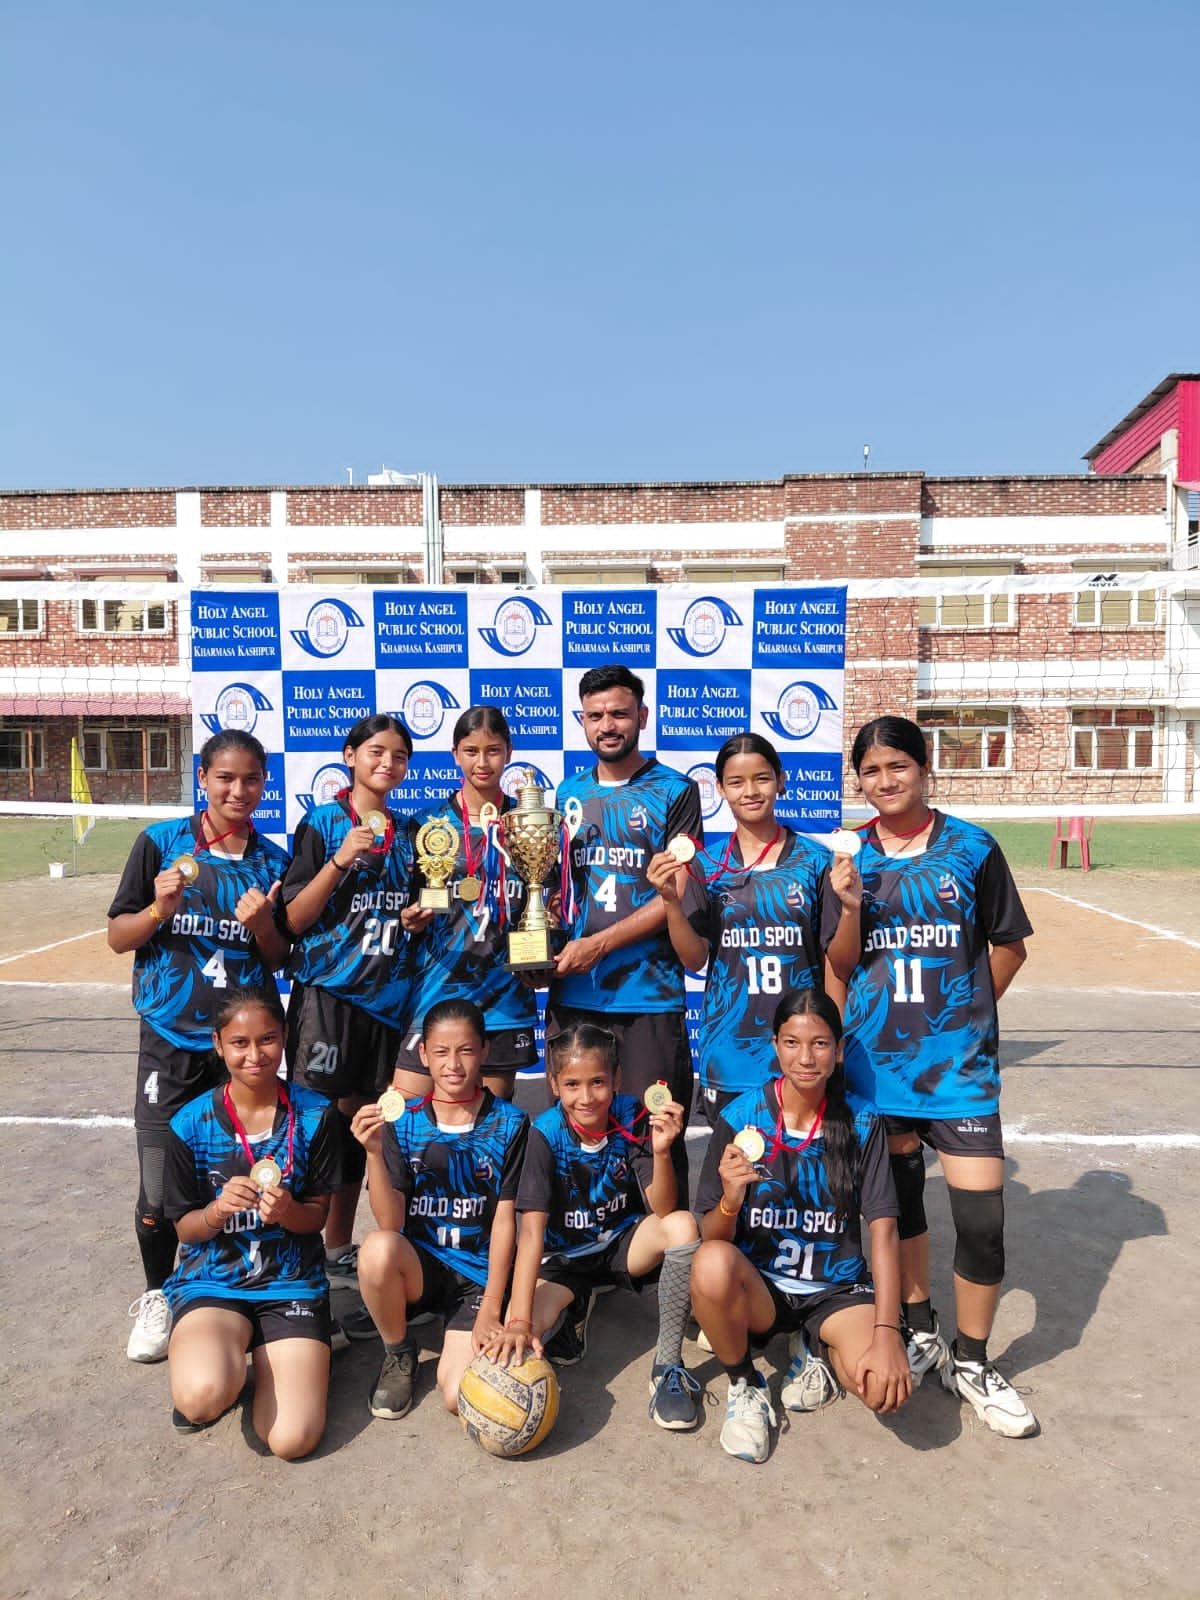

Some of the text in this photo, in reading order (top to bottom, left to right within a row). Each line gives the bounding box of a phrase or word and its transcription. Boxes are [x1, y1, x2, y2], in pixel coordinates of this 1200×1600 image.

[198, 605, 269, 619] HOLY ANGEL
[385, 601, 456, 616] HOLY ANGEL
[574, 601, 645, 614] HOLY ANGEL
[765, 601, 839, 614] HOLY ANGEL
[191, 625, 277, 639] PUBLIC SCHOOL
[377, 621, 464, 636] PUBLIC SCHOOL
[565, 621, 653, 634] PUBLIC SCHOOL
[757, 621, 846, 635] PUBLIC SCHOOL
[194, 645, 275, 656] KHARMASA KASHIPUR
[380, 642, 463, 653] KHARMASA KASHIPUR
[568, 641, 651, 653] KHARMASA KASHIPUR
[758, 641, 843, 653] KHARMASA KASHIPUR
[293, 685, 365, 699] HOLY ANGEL
[480, 684, 552, 697] HOLY ANGEL
[667, 684, 739, 698] HOLY ANGEL
[287, 706, 326, 719] PUBLIC
[515, 704, 559, 717] SCHOOL
[660, 704, 747, 718] PUBLIC SCHOOL
[289, 726, 331, 736] KHARMASA
[520, 724, 557, 735] KASHIPUR
[662, 725, 704, 735] KHARMASA
[404, 768, 460, 780] LY ANGEL
[796, 768, 834, 781] ANGEL
[261, 790, 282, 800] OOL
[390, 786, 460, 799] UBLIC SCHO
[796, 787, 842, 800] SCHOOL
[250, 809, 280, 818] ASHIPUR
[773, 807, 840, 818] RMASA KASHIPUR
[574, 846, 645, 868] GOLD SPOT
[594, 874, 617, 912] 4
[171, 914, 253, 944] GOLD SPO
[910, 924, 961, 947] SPOT
[722, 926, 803, 948] GOLD SPOT
[201, 949, 228, 988] 4
[746, 955, 782, 994] 18
[893, 958, 925, 1003] 11
[307, 1041, 339, 1074] 20
[144, 1071, 159, 1104] 4
[409, 1196, 448, 1217] GOLD
[223, 1208, 257, 1234] OLD
[564, 1210, 596, 1229] GOL
[750, 1207, 798, 1229] GOLD
[774, 1238, 814, 1281] 21
